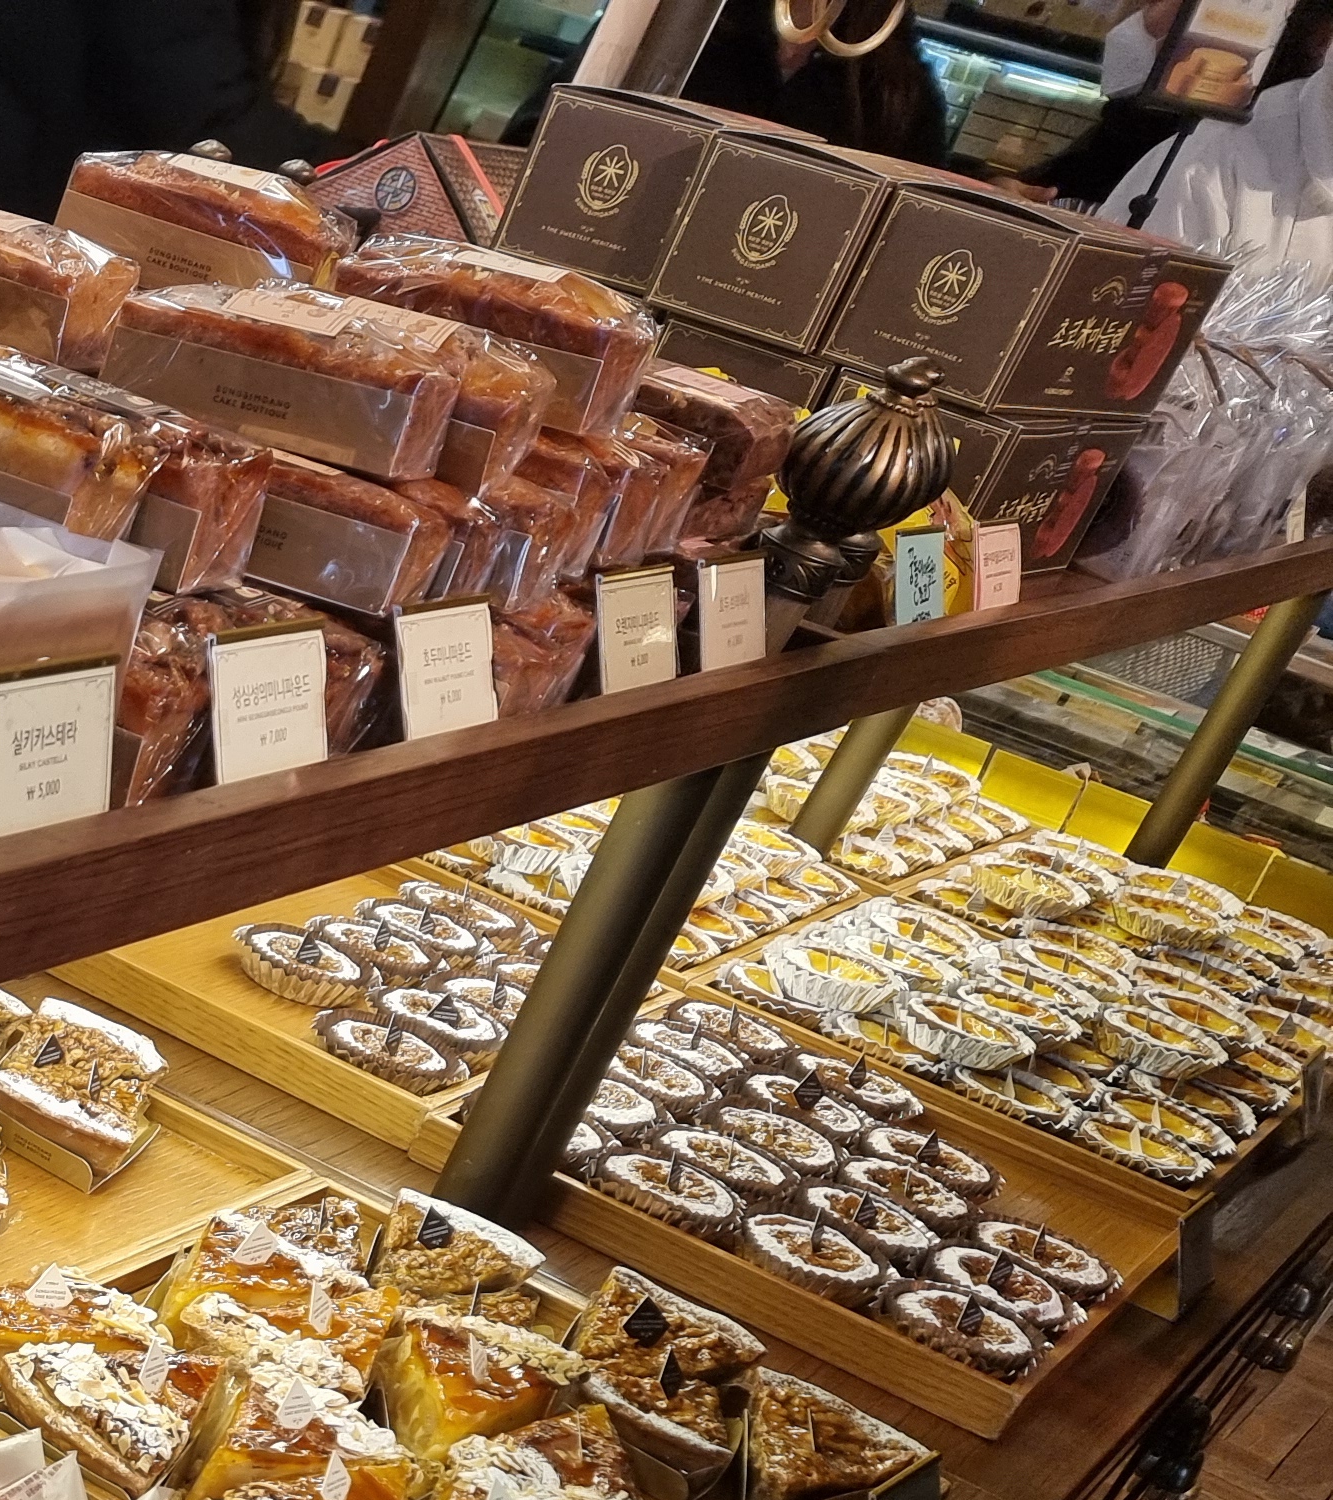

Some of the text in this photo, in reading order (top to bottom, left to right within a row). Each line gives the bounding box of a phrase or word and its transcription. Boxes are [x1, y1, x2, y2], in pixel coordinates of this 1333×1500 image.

[146, 255, 209, 281] CAKE BOUTIQUE
[148, 247, 212, 273] SUNGSIMDANG
[213, 394, 288, 420] CAKE BOUTIQUE
[215, 384, 291, 410] SUNGSIMDANG
[12, 719, 78, 756] 실키카스테라
[38, 779, 61, 800] 5,000
